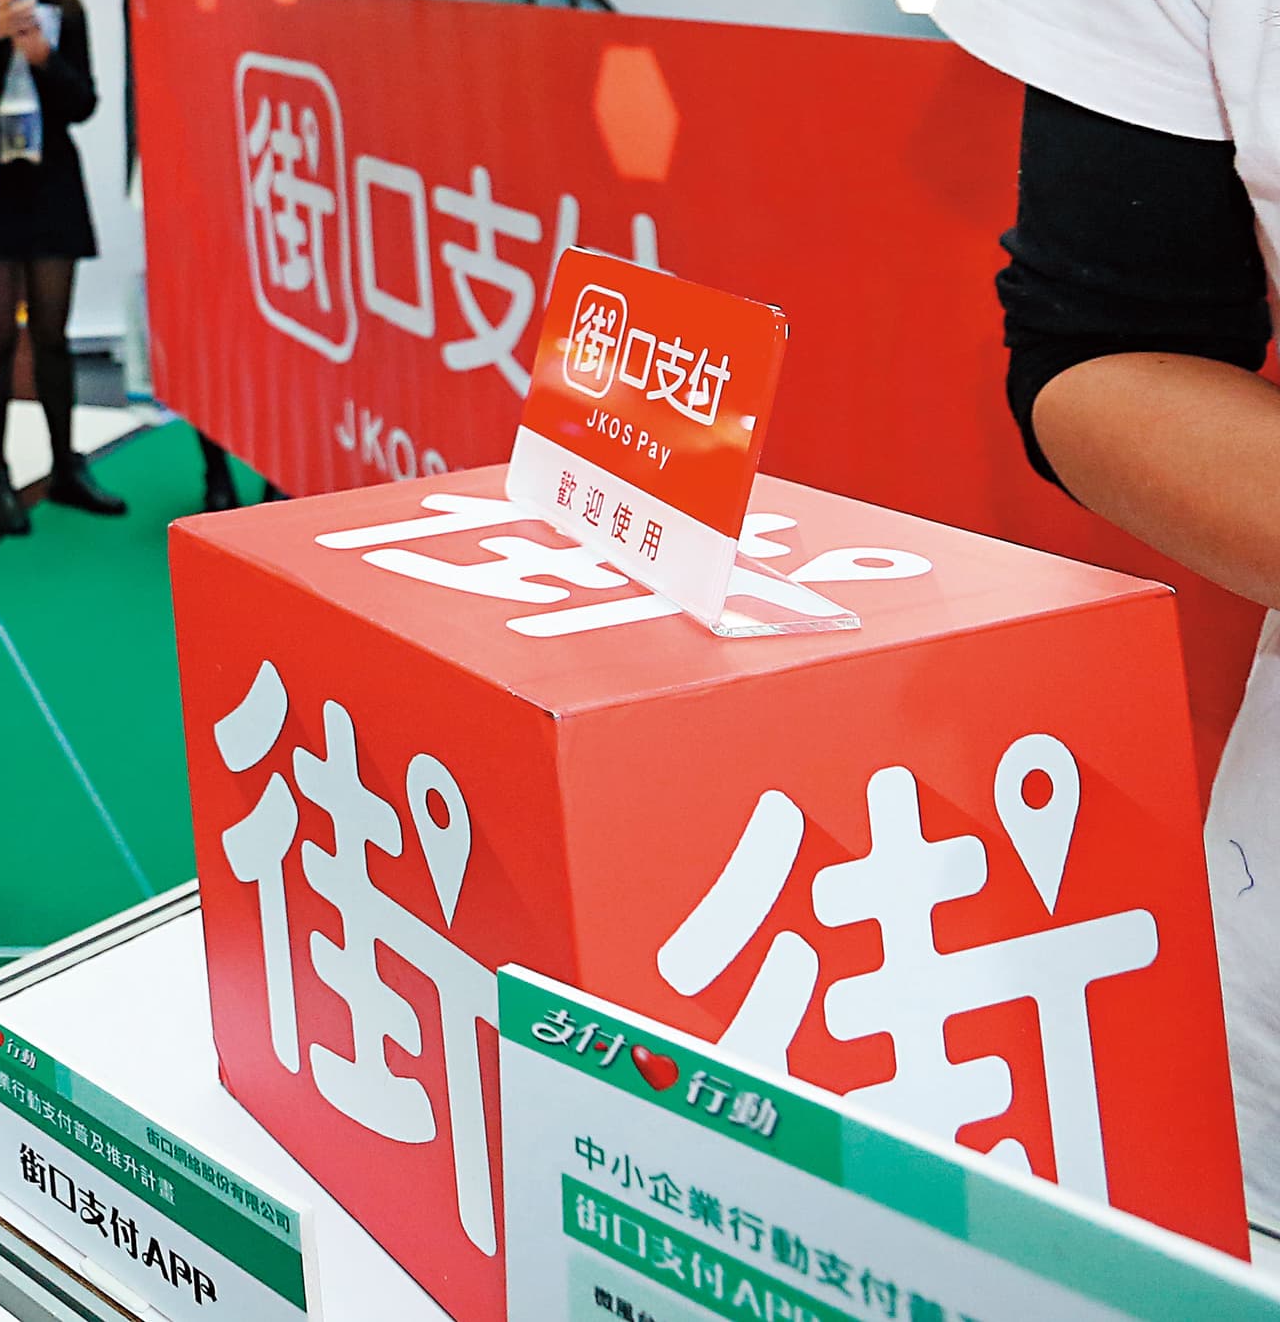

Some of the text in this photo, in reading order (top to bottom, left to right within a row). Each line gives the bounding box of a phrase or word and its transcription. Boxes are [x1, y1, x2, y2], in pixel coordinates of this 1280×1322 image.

[563, 284, 731, 426] 街口支付
[586, 408, 672, 470] JKOS Pay
[557, 470, 663, 561] 歡迎使用
[214, 659, 498, 1256] 街
[657, 733, 1159, 1207] 街
[531, 1009, 780, 1139] 支付 行動
[19, 1142, 218, 1306] 街口支付APP
